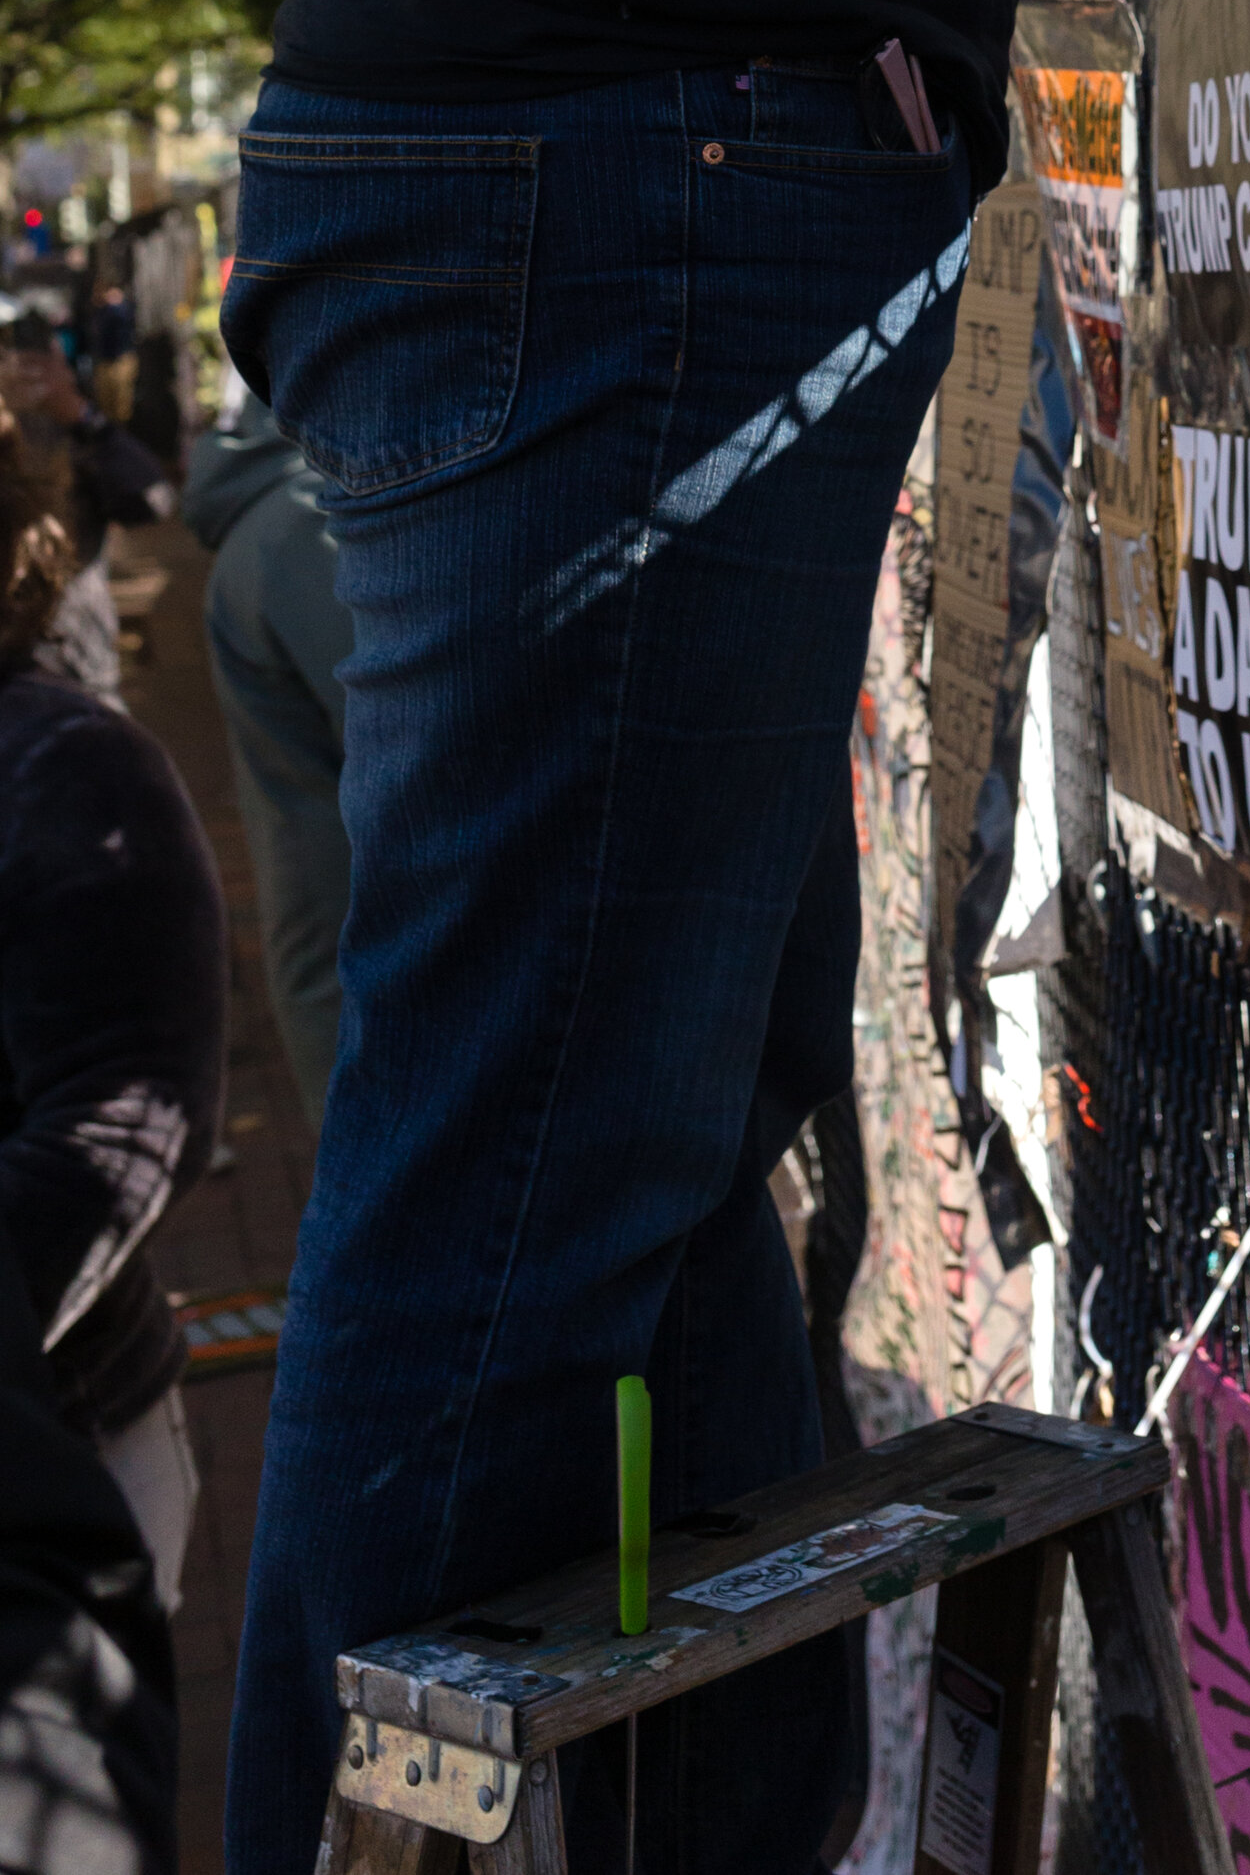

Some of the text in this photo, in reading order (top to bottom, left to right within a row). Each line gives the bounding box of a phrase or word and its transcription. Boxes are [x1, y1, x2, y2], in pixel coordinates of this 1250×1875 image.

[1188, 78, 1220, 168] DO
[1157, 183, 1232, 274] TRUMP
[1174, 570, 1199, 703] A
[1177, 710, 1236, 855] TO
